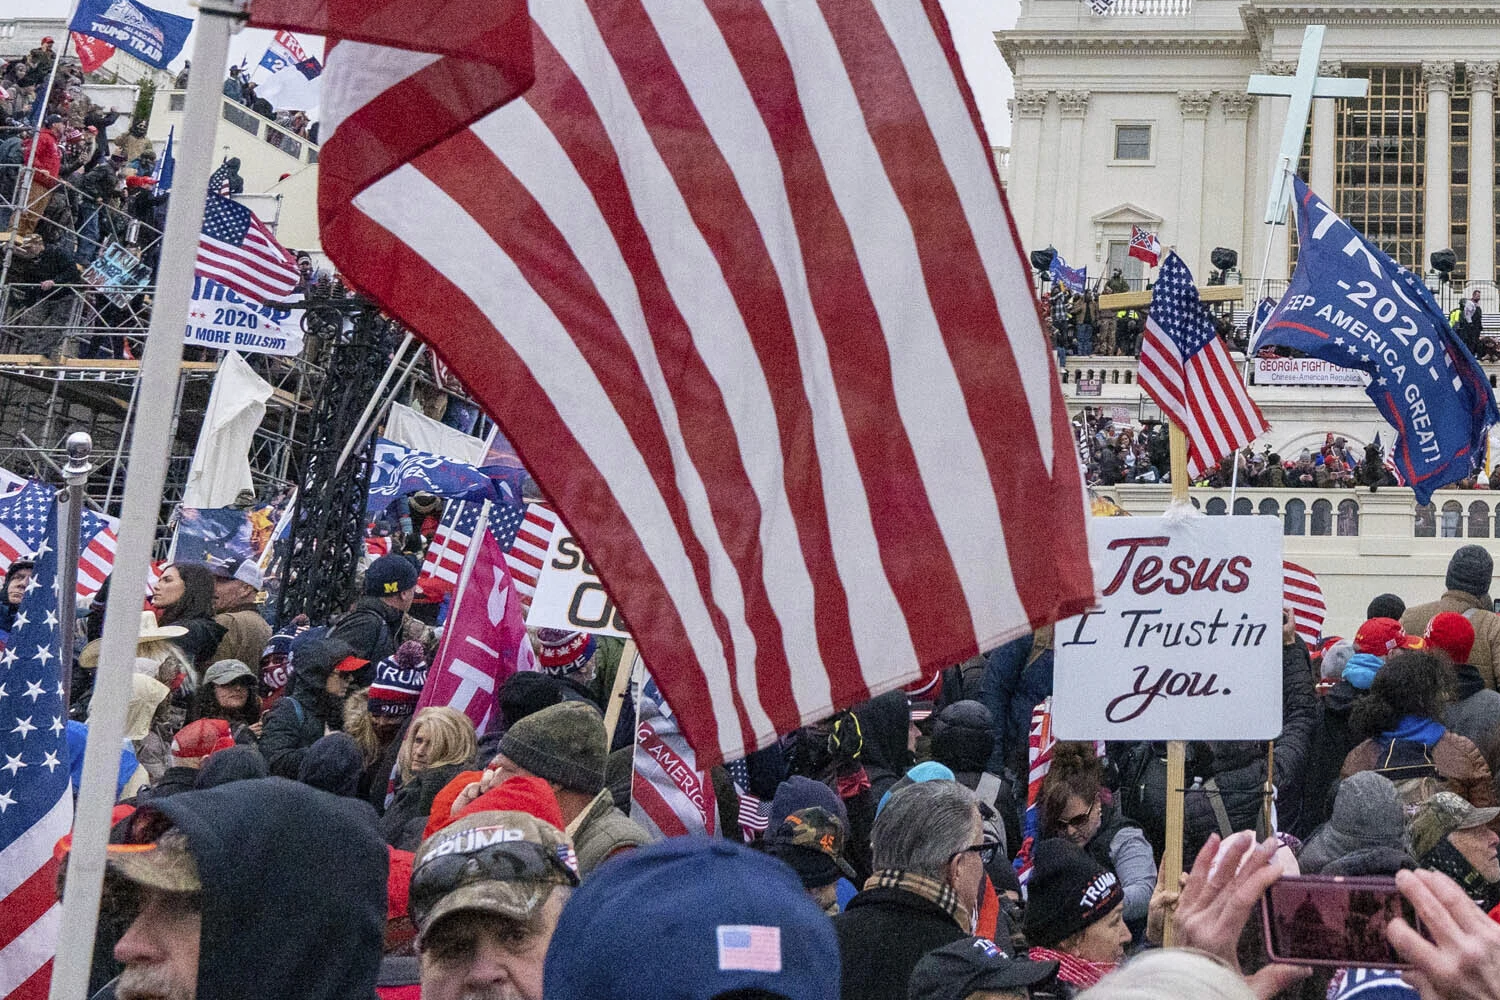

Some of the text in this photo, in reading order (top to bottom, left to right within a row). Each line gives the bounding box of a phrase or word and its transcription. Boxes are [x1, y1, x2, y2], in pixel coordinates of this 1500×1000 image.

[91, 21, 130, 42] TRUMP
[213, 308, 258, 329] 2020
[195, 327, 231, 344] MORE
[1260, 361, 1299, 372] GEORGIA
[1301, 361, 1327, 372] FIGHT
[1315, 304, 1406, 384] AMERICA
[1404, 384, 1442, 464] GREAT!
[1102, 536, 1252, 596] Jesus
[383, 581, 398, 593] M
[1062, 608, 1267, 648] I Trust in
[376, 660, 428, 686] TRUM
[1105, 665, 1231, 723] you.
